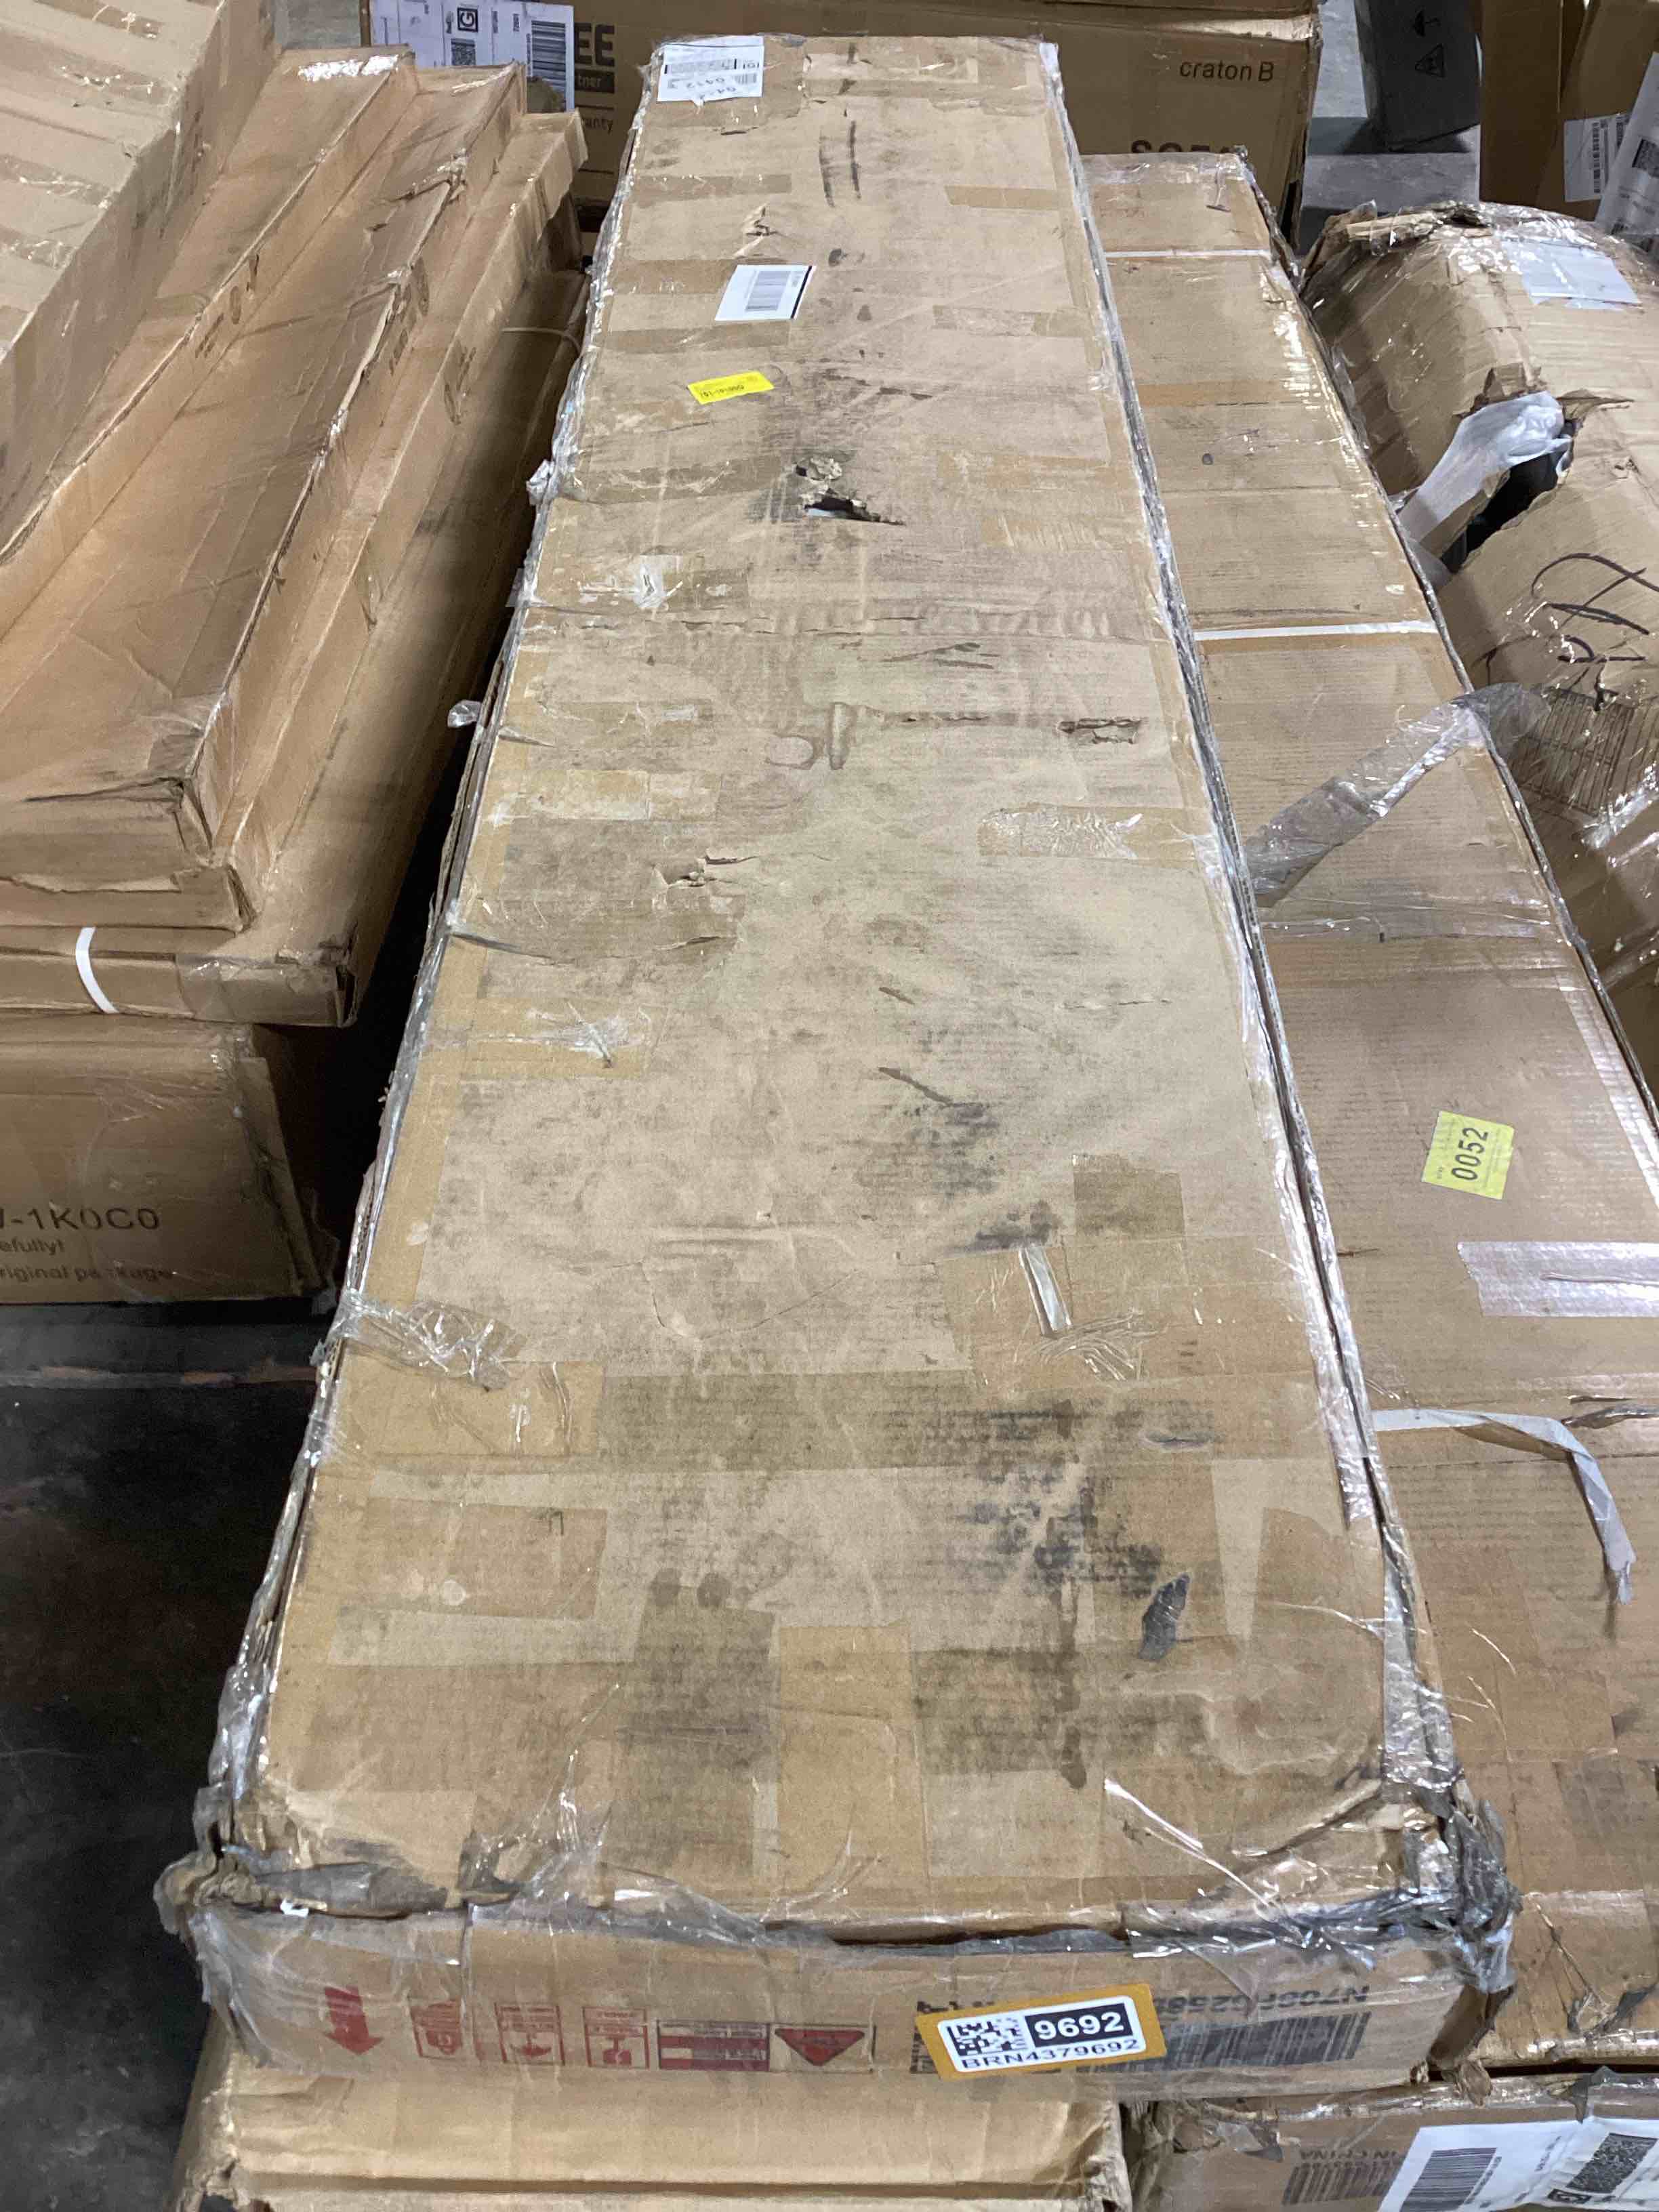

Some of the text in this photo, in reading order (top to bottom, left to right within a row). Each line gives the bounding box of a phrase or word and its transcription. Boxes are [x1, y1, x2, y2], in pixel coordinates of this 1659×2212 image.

[1179, 61, 1275, 82] craton B
[1451, 1127, 1489, 1181] 0052
[1033, 2011, 1125, 2040] 9692
[962, 2039, 1139, 2068] BRN4379692
